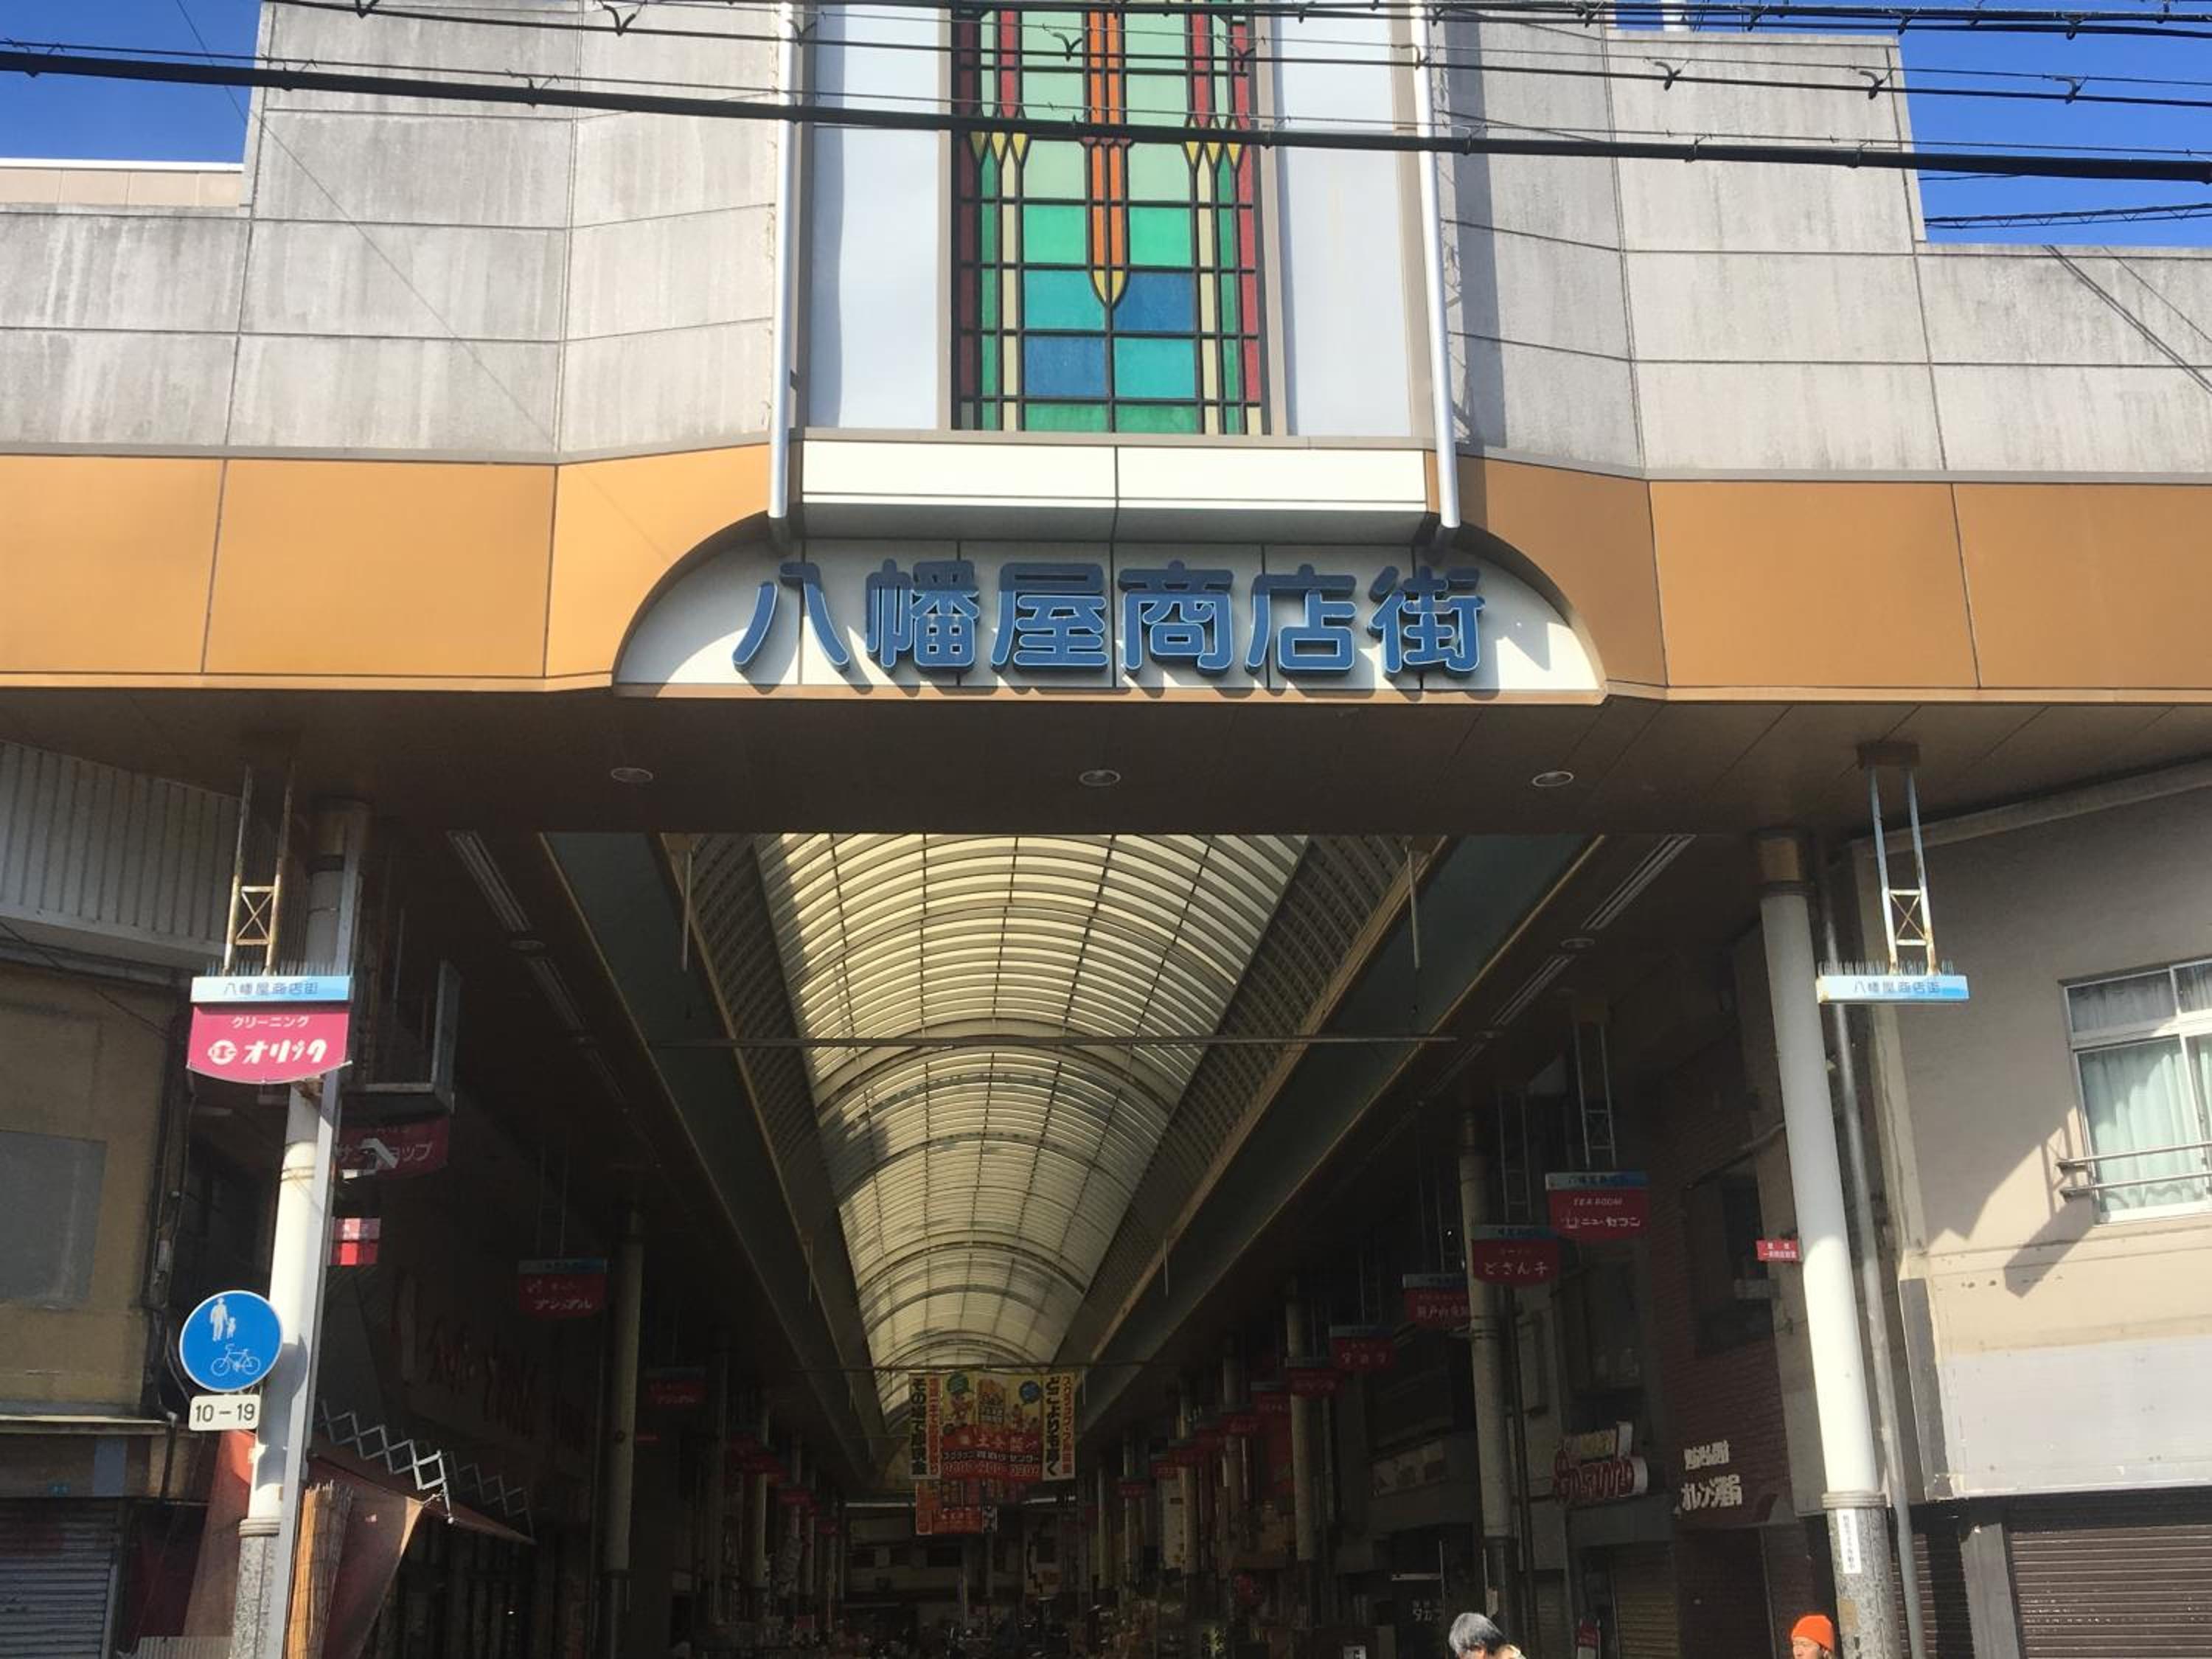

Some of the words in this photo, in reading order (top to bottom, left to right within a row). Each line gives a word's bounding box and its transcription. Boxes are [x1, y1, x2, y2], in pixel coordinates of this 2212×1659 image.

[732, 559, 1485, 676] 八幡屋商店街
[232, 1015, 310, 1029] クリーニング
